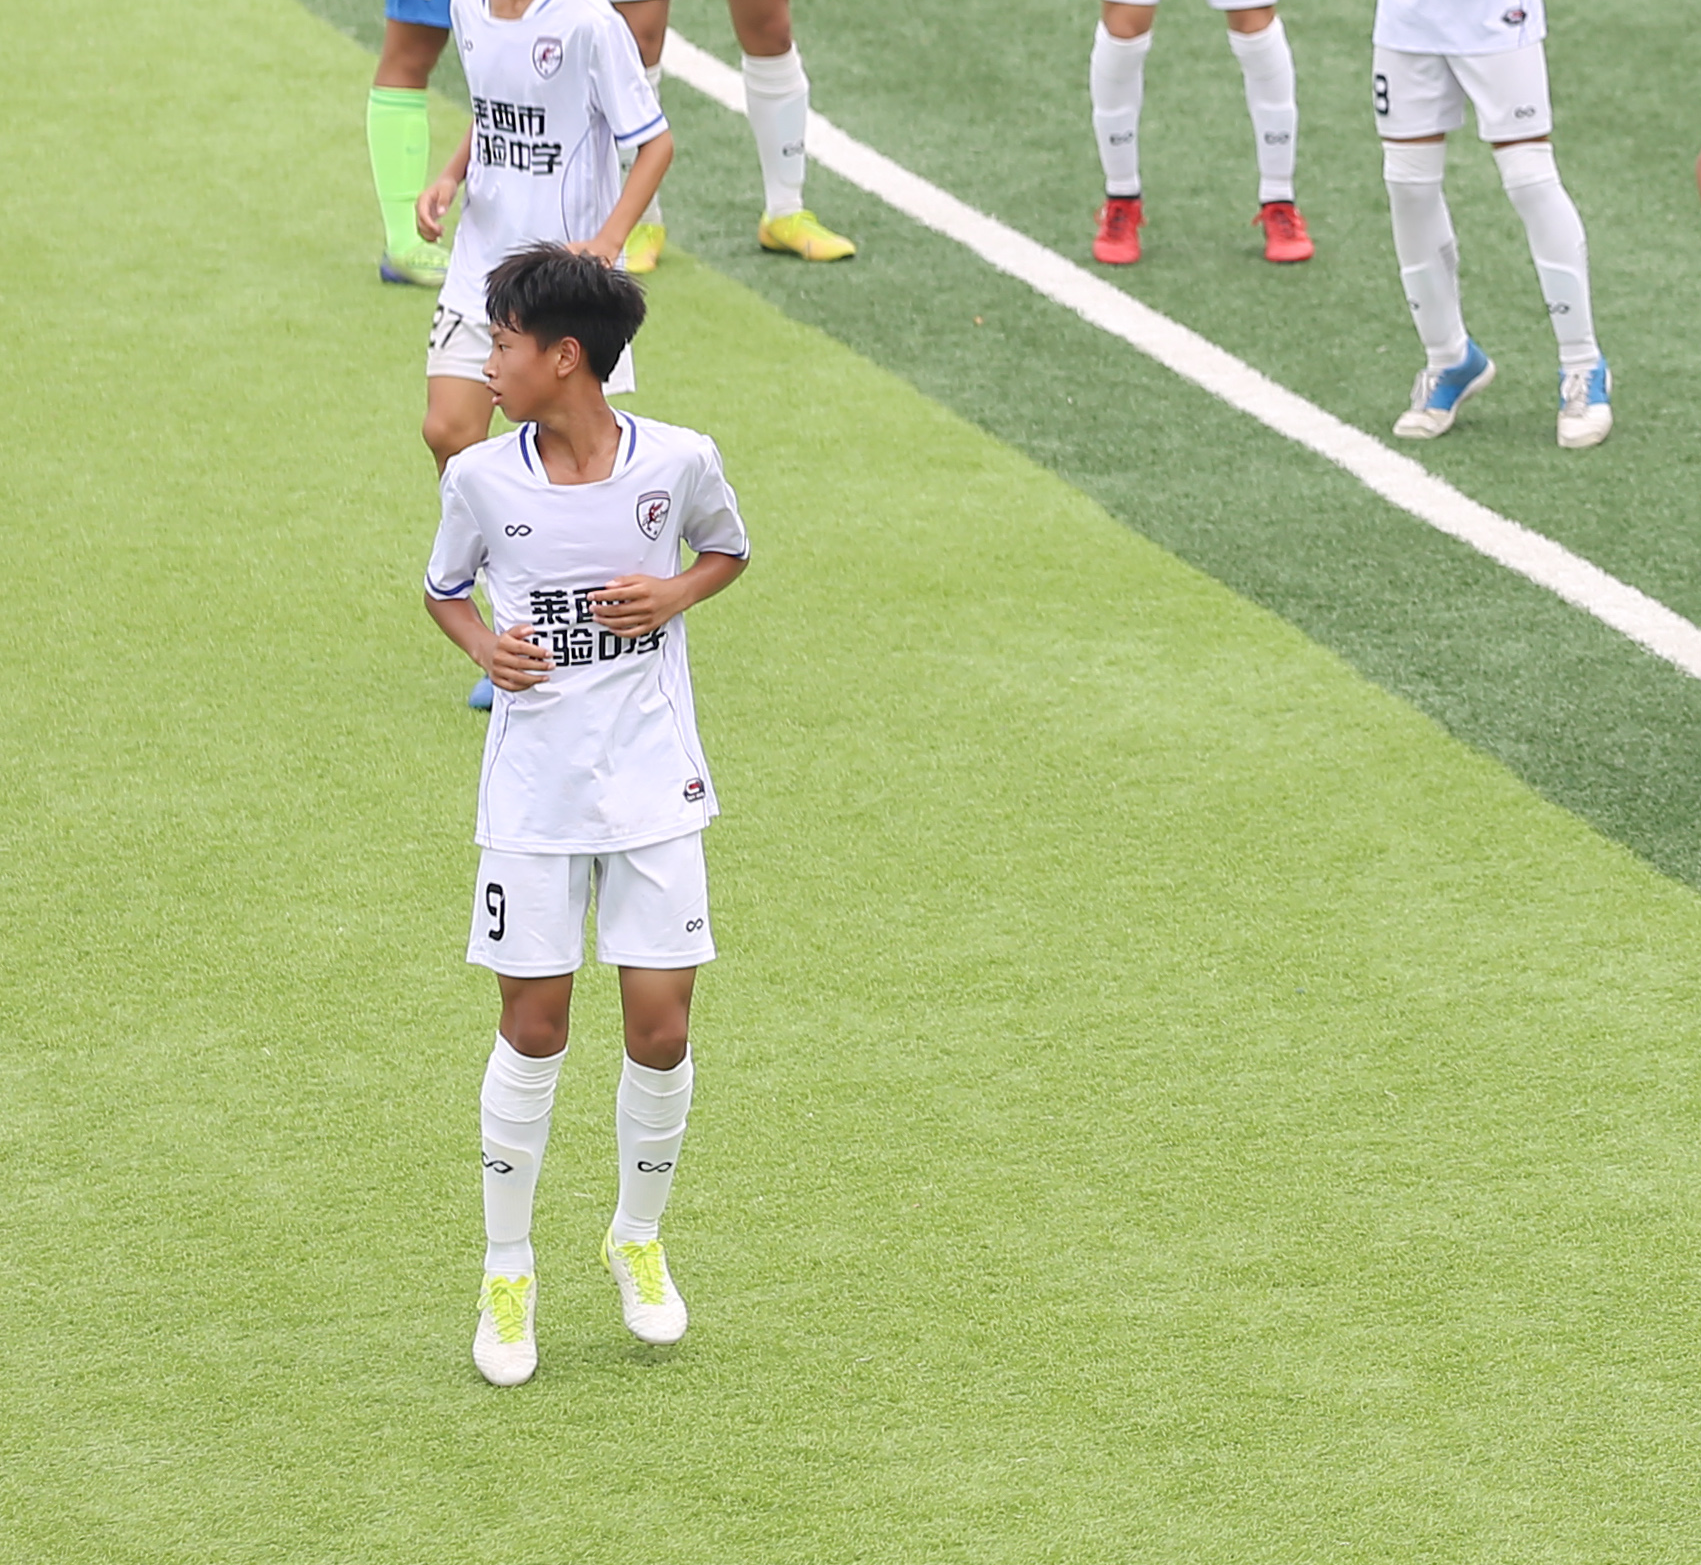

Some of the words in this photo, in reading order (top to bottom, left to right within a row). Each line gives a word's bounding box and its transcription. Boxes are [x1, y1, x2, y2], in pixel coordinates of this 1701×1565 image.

[477, 133, 563, 176] 验中学
[486, 882, 506, 943] 9
